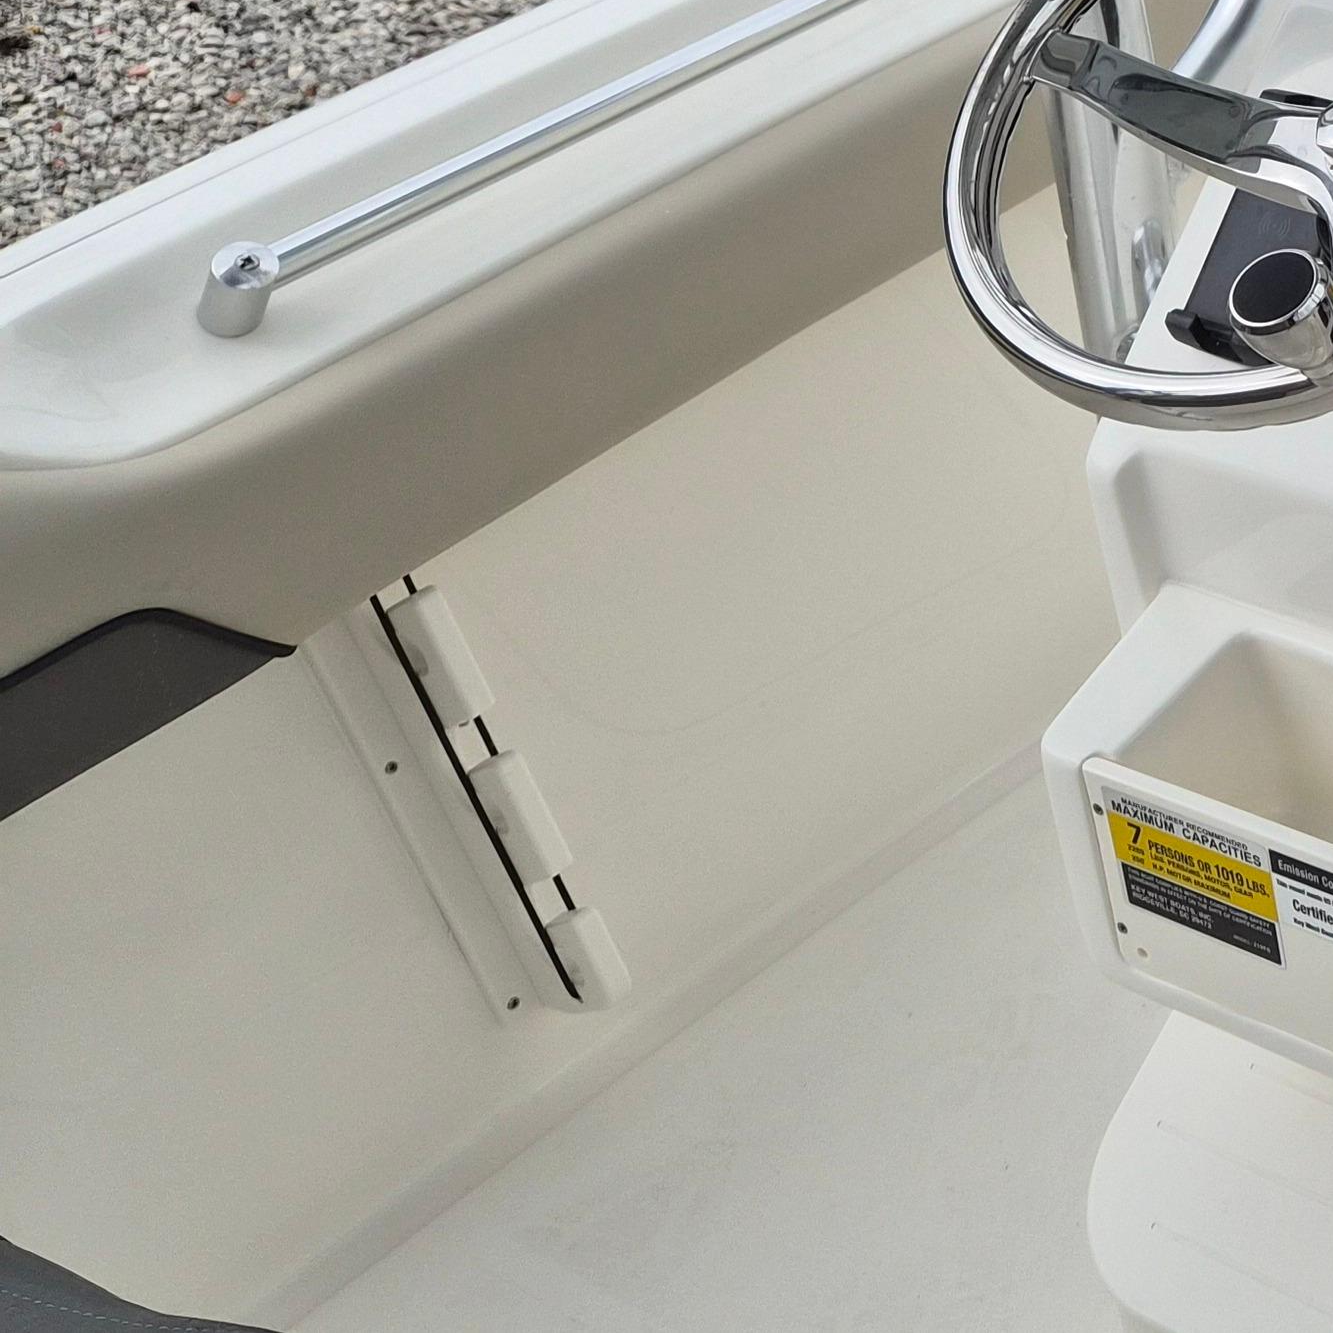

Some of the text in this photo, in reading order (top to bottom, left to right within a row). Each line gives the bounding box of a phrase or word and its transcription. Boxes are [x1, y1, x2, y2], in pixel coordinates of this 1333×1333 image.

[1111, 800, 1261, 866] MAXIMUM CAPACITIES
[1121, 797, 1247, 850] MANUFACTURER RECOMMENDED
[1126, 821, 1145, 848] 7
[1147, 839, 1193, 866] PERSONS
[1196, 858, 1212, 875] OR
[1215, 864, 1243, 886] 1019
[1246, 878, 1268, 897] LBS.
[1278, 858, 1318, 884] Emission
